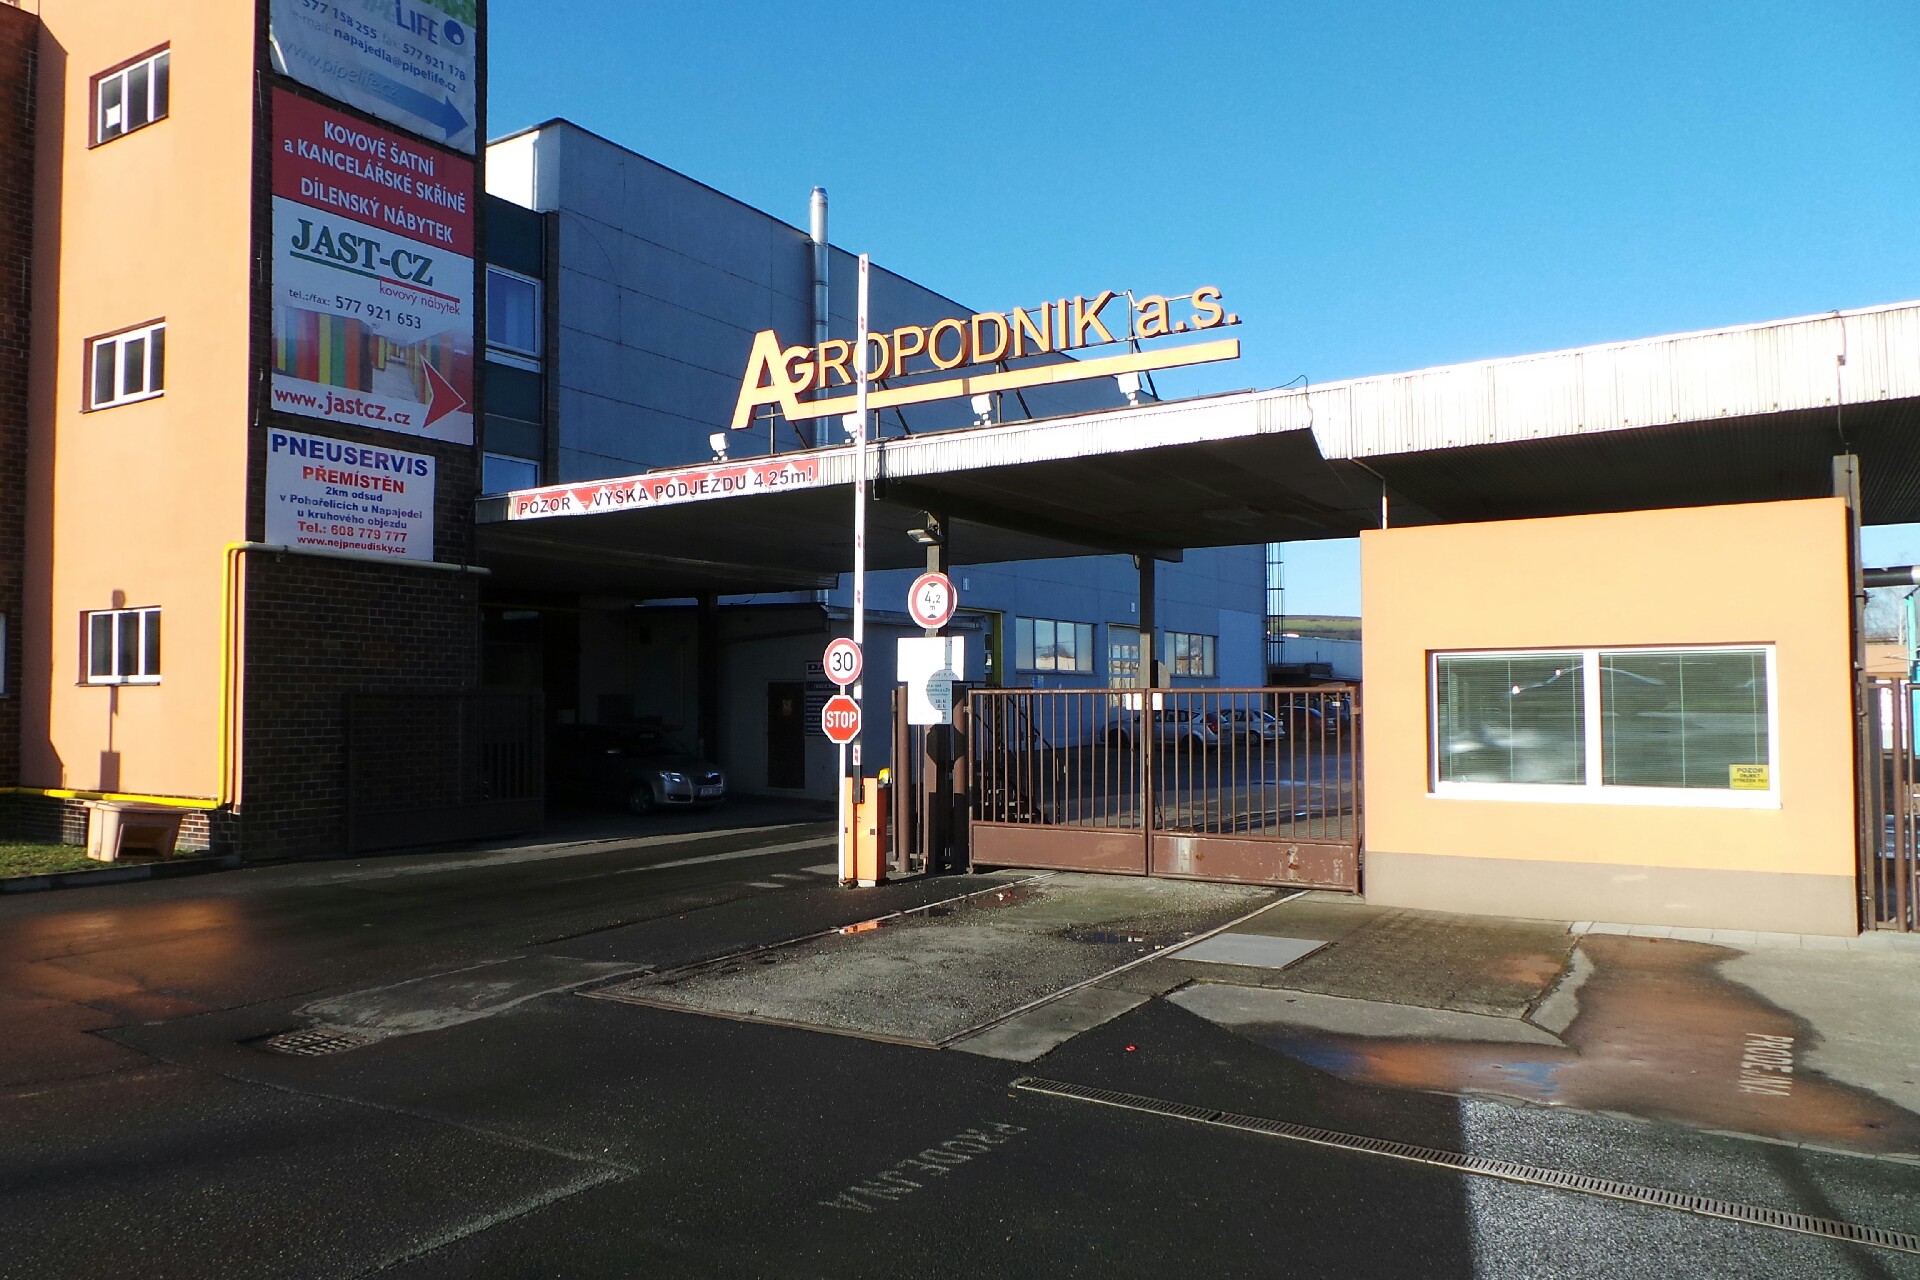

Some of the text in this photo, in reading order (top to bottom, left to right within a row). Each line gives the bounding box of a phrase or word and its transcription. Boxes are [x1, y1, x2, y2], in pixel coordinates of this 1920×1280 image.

[333, 8, 354, 27] 158
[356, 21, 377, 39] 255
[403, 43, 423, 60] 577
[425, 53, 445, 71] 921
[448, 64, 466, 81] 178
[334, 27, 456, 93] napajedla@pipelife.cz
[324, 120, 435, 177] KOVOVÉ ŠATNÍ
[284, 139, 466, 213] a KANCELÁŘSKÉ SKŘÍNĚ
[301, 175, 453, 244] DÍLENSKÝ NÁBYTEK
[291, 218, 433, 287] JAST-CZ
[336, 295, 361, 313] 577
[367, 304, 391, 322] 921
[397, 312, 422, 329] 653
[379, 281, 461, 316] kovový nábytek
[730, 285, 1241, 430] AGROPODNIK a.s.
[275, 389, 411, 426] www.jastcz.cz
[272, 433, 428, 477] PNEUSERVIS
[302, 465, 404, 494] PŘEMÍSTĚN
[325, 486, 383, 502] 2km odsud
[519, 496, 571, 516] POZOR
[654, 474, 747, 500] PODJEZDU
[279, 494, 287, 502] v
[361, 504, 369, 513] u
[297, 510, 407, 530] u kruhového objezdu
[297, 521, 407, 543] Tel.: 608 779 777
[297, 536, 406, 554] www.nejpneudisky.cz
[924, 590, 941, 604] 4,2
[832, 652, 854, 672] 30
[826, 711, 857, 729] STOP
